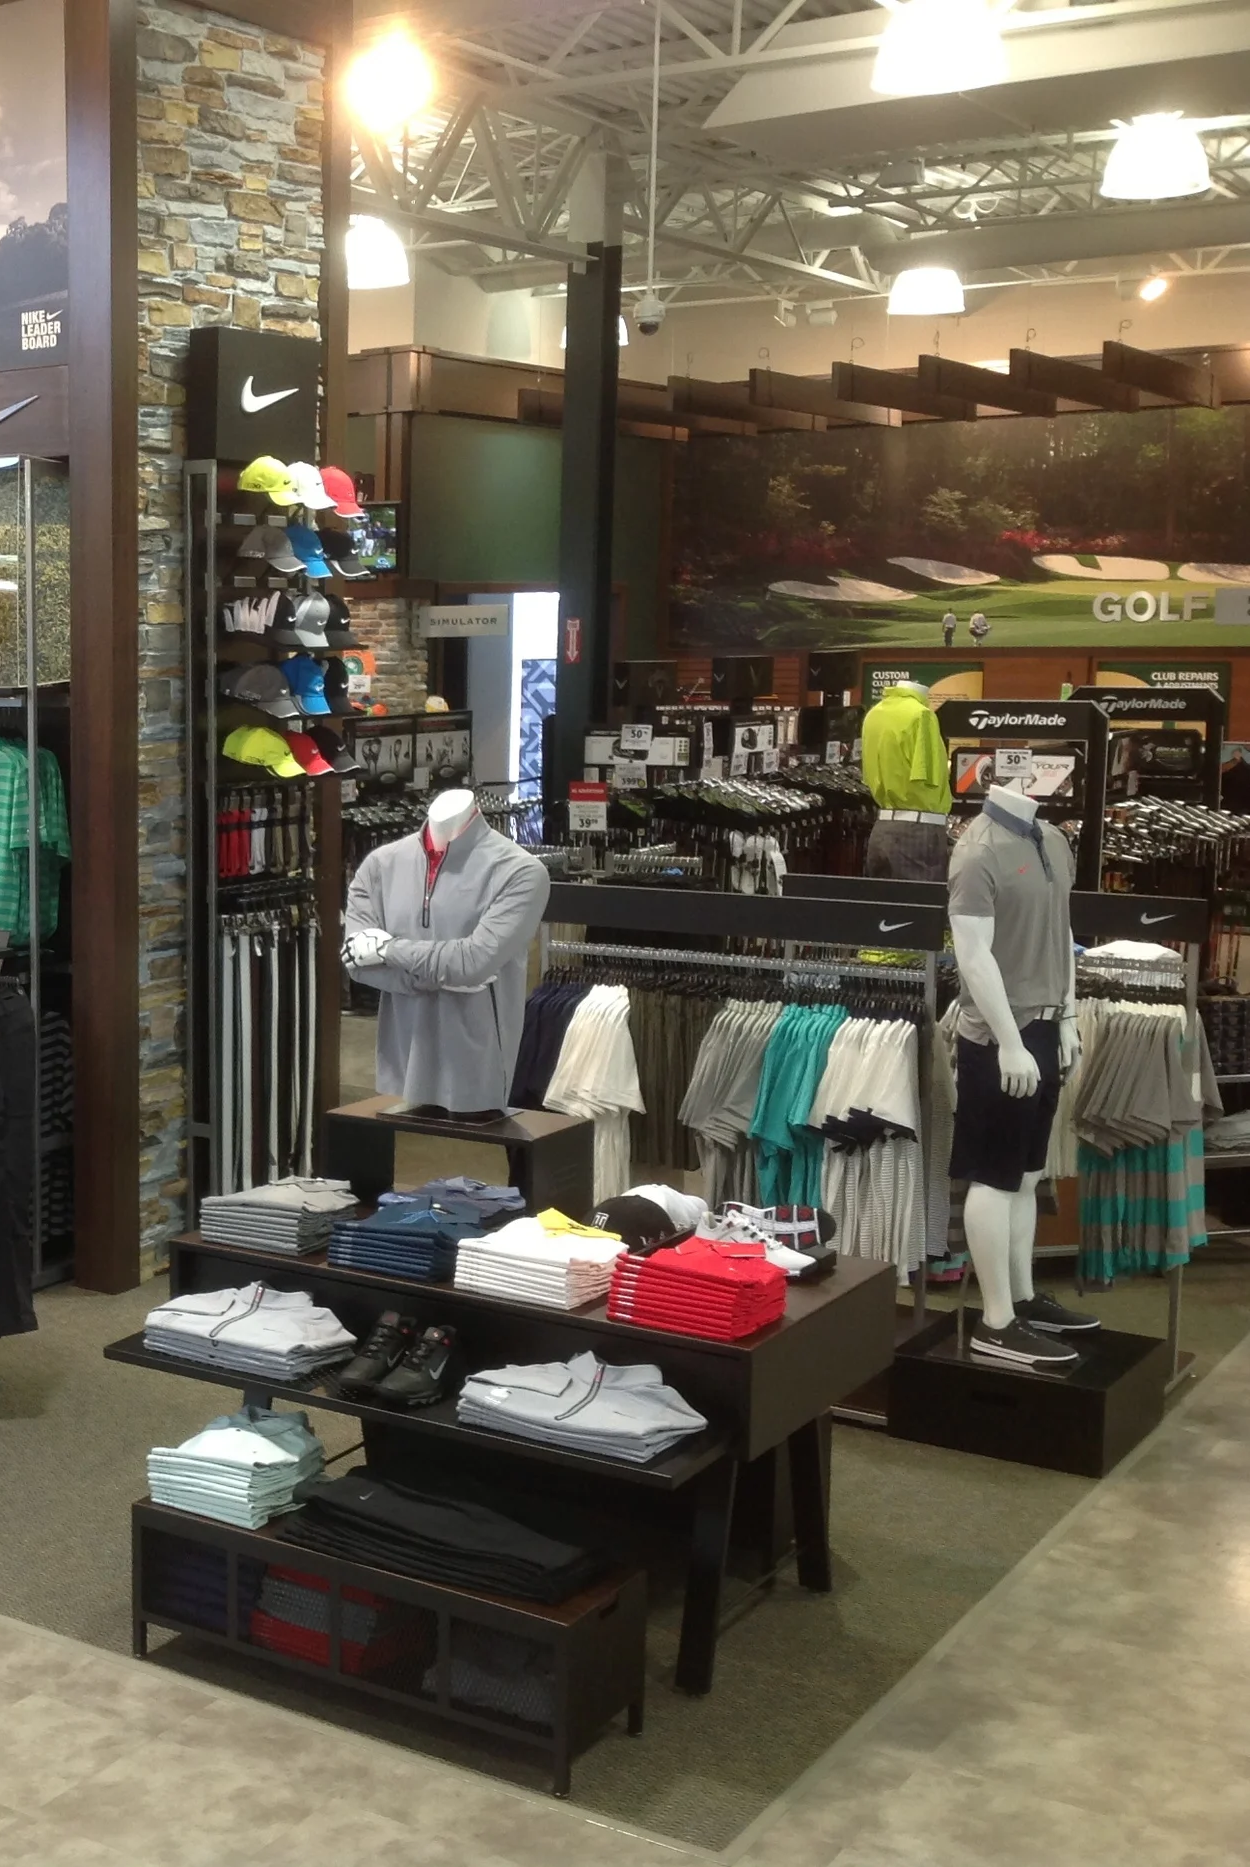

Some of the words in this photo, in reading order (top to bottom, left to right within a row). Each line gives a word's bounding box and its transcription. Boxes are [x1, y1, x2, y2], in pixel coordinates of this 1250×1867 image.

[21, 310, 45, 325] NIKE
[22, 321, 61, 337] LEADER
[22, 335, 57, 350] BOARD
[1092, 590, 1210, 623] GOLF
[430, 617, 498, 626] SIMULATOR
[872, 671, 910, 680] CUSTOM
[1152, 671, 1177, 682] CLUB
[1178, 671, 1219, 682] REPAIRS
[1100, 695, 1187, 713] TaylorMade
[968, 709, 1067, 730] TaylorMade
